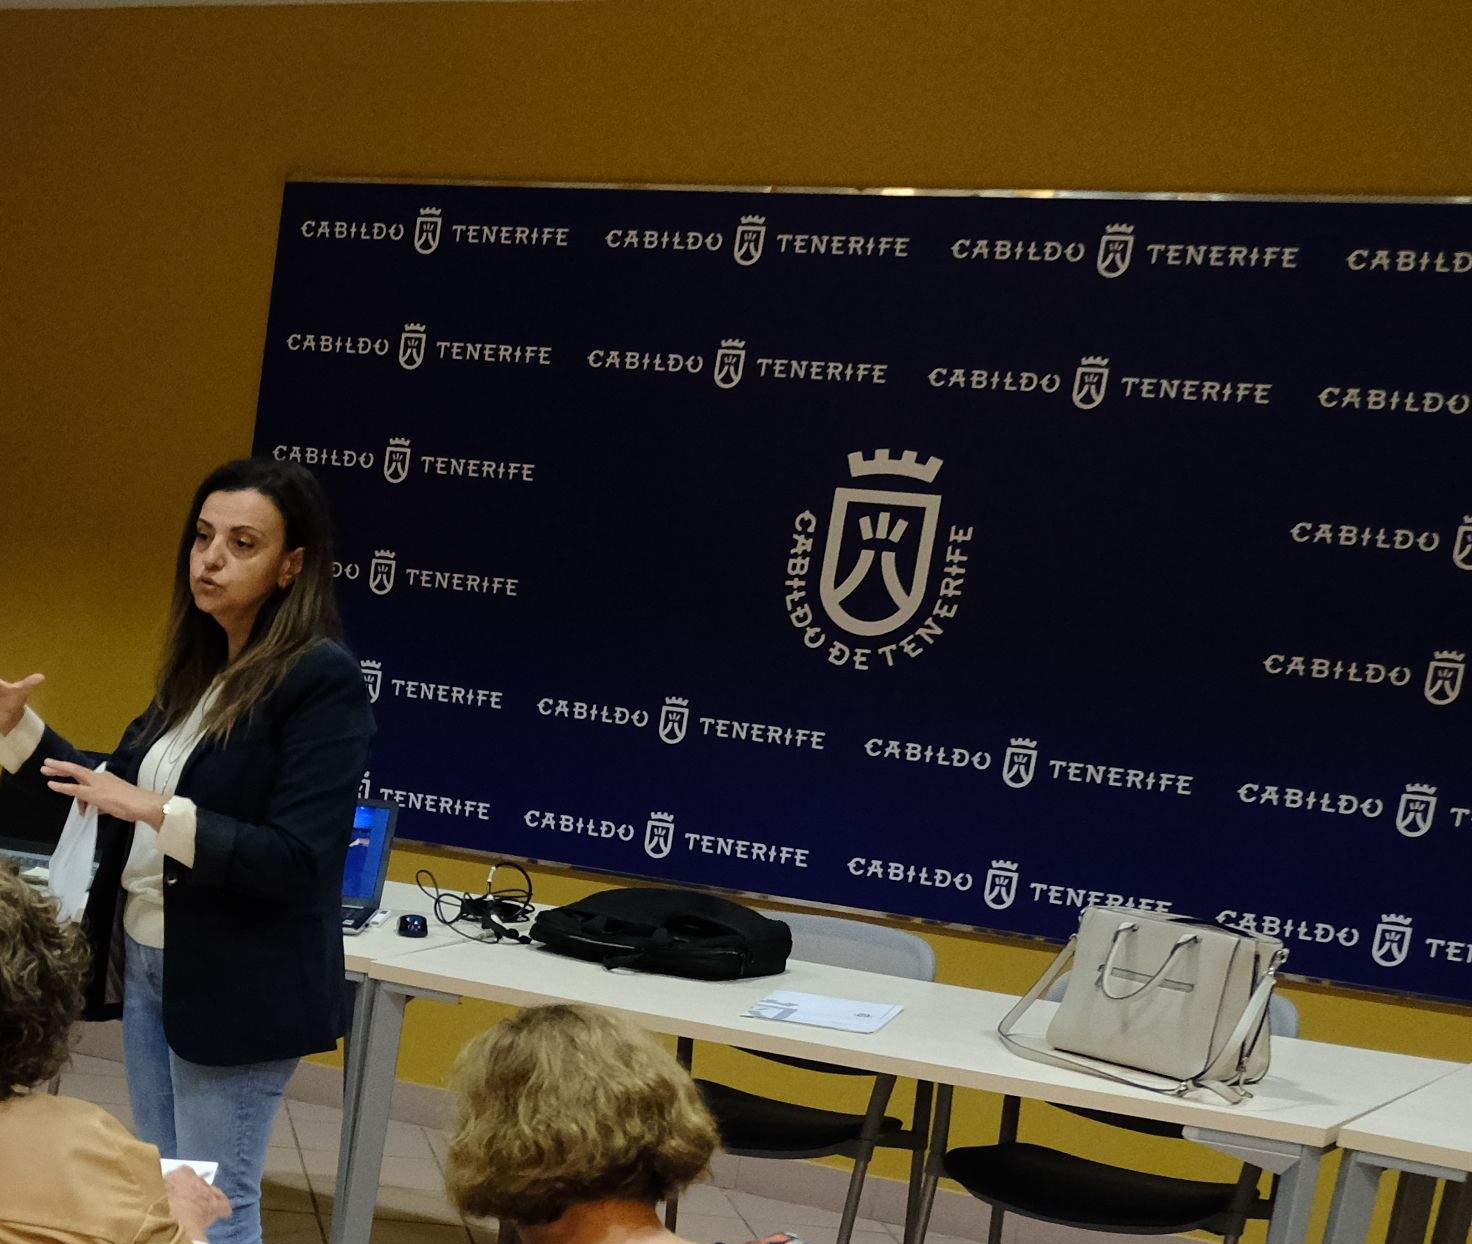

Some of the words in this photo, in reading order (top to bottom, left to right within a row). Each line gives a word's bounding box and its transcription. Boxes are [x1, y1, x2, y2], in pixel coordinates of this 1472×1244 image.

[300, 220, 405, 241] CABILDO
[452, 224, 570, 246] TENERIFE
[604, 229, 723, 251] CABILDO
[776, 234, 910, 257] TENERIFE
[950, 238, 1085, 263] CABILDO
[1146, 244, 1300, 268] TENERIFE
[1345, 249, 1472, 273] CABILD
[286, 333, 389, 356] CABILDO
[436, 341, 553, 365] TENERIFE
[587, 349, 704, 374] CABILDO
[756, 358, 888, 384] TENERIFE
[927, 367, 1061, 393] CABILDO
[1120, 377, 1273, 405] TENERIFE
[1317, 387, 1470, 415] CABILDO
[272, 444, 375, 469] CABILDO
[420, 456, 536, 482] TENERIFE
[1289, 521, 1440, 552] CABILDO
[405, 568, 519, 597] TENERIFE
[784, 509, 827, 650] CABILDO
[827, 640, 872, 671] DE
[877, 524, 975, 668] TENERIFE
[1262, 654, 1411, 686] CABILDO
[391, 679, 503, 710] TENERIFE
[536, 697, 649, 728] CABILDO
[699, 717, 826, 750] TENERIFE
[863, 738, 992, 770] CABILDO
[1049, 759, 1194, 795] TENERIFE
[378, 788, 491, 821] TENERIFE
[1236, 783, 1384, 818] CABILDO
[523, 809, 635, 842] CABILDO
[684, 832, 810, 868] TENERIFE
[846, 857, 973, 891] CABILDO
[1215, 909, 1360, 948] CABILDO
